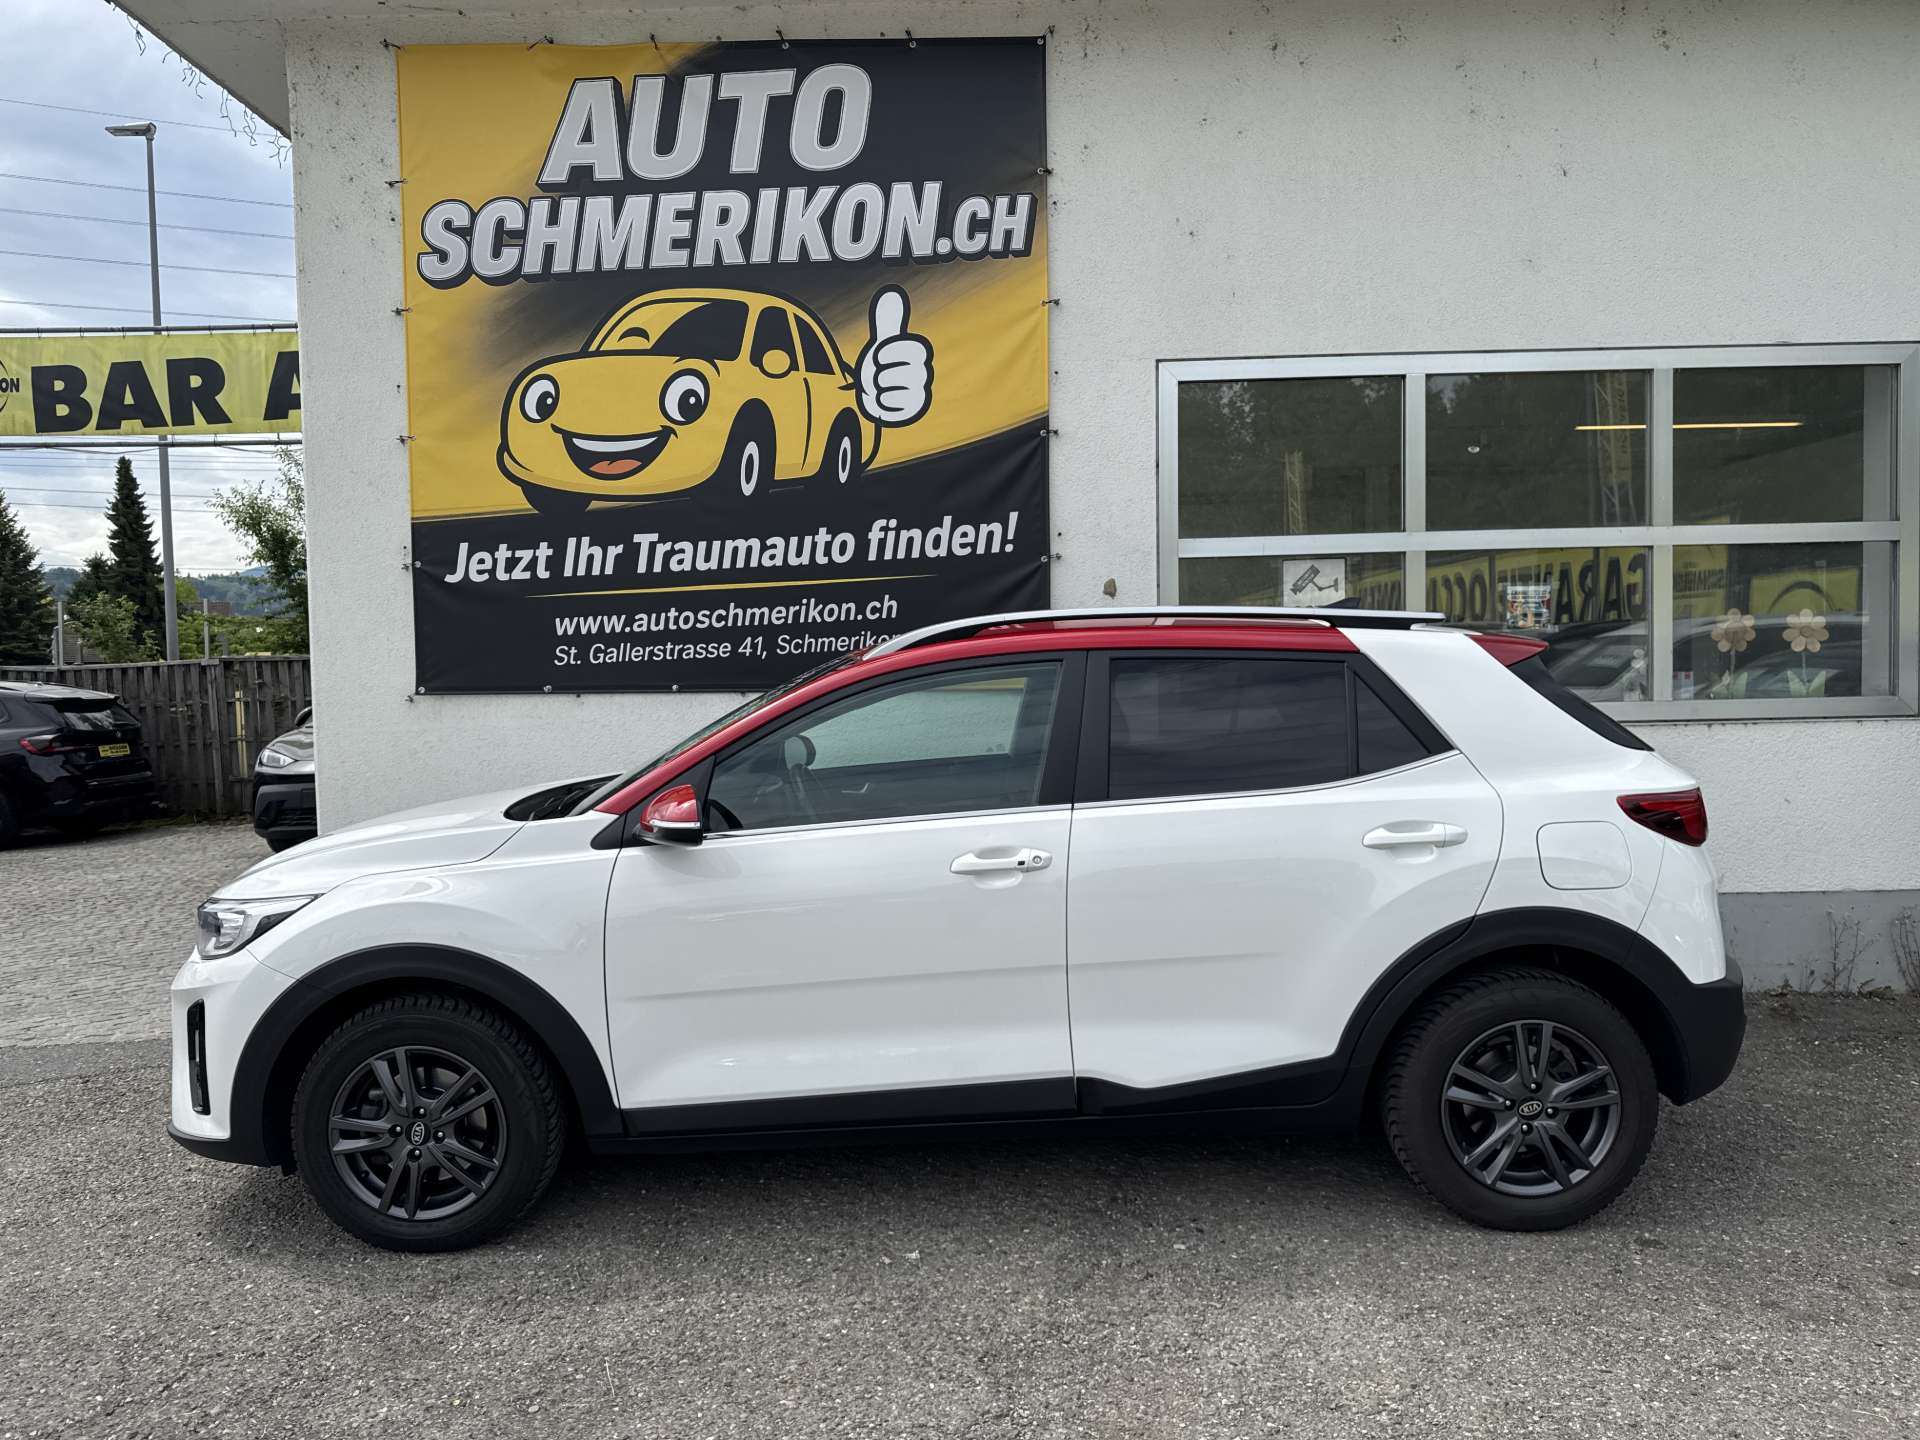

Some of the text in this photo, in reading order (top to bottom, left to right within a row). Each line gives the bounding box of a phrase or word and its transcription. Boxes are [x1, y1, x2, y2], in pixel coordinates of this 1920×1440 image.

[538, 62, 873, 184] AUTO
[418, 180, 1033, 282] SCHMERIKON.CH
[31, 357, 232, 433] BAR
[444, 511, 1019, 583] Jetzt Ihr Traumauto finden!
[554, 645, 582, 666] St.
[589, 641, 732, 664] Gallerstrasse
[738, 636, 768, 660] 41,
[555, 594, 898, 636] www.autoschmerikon.ch
